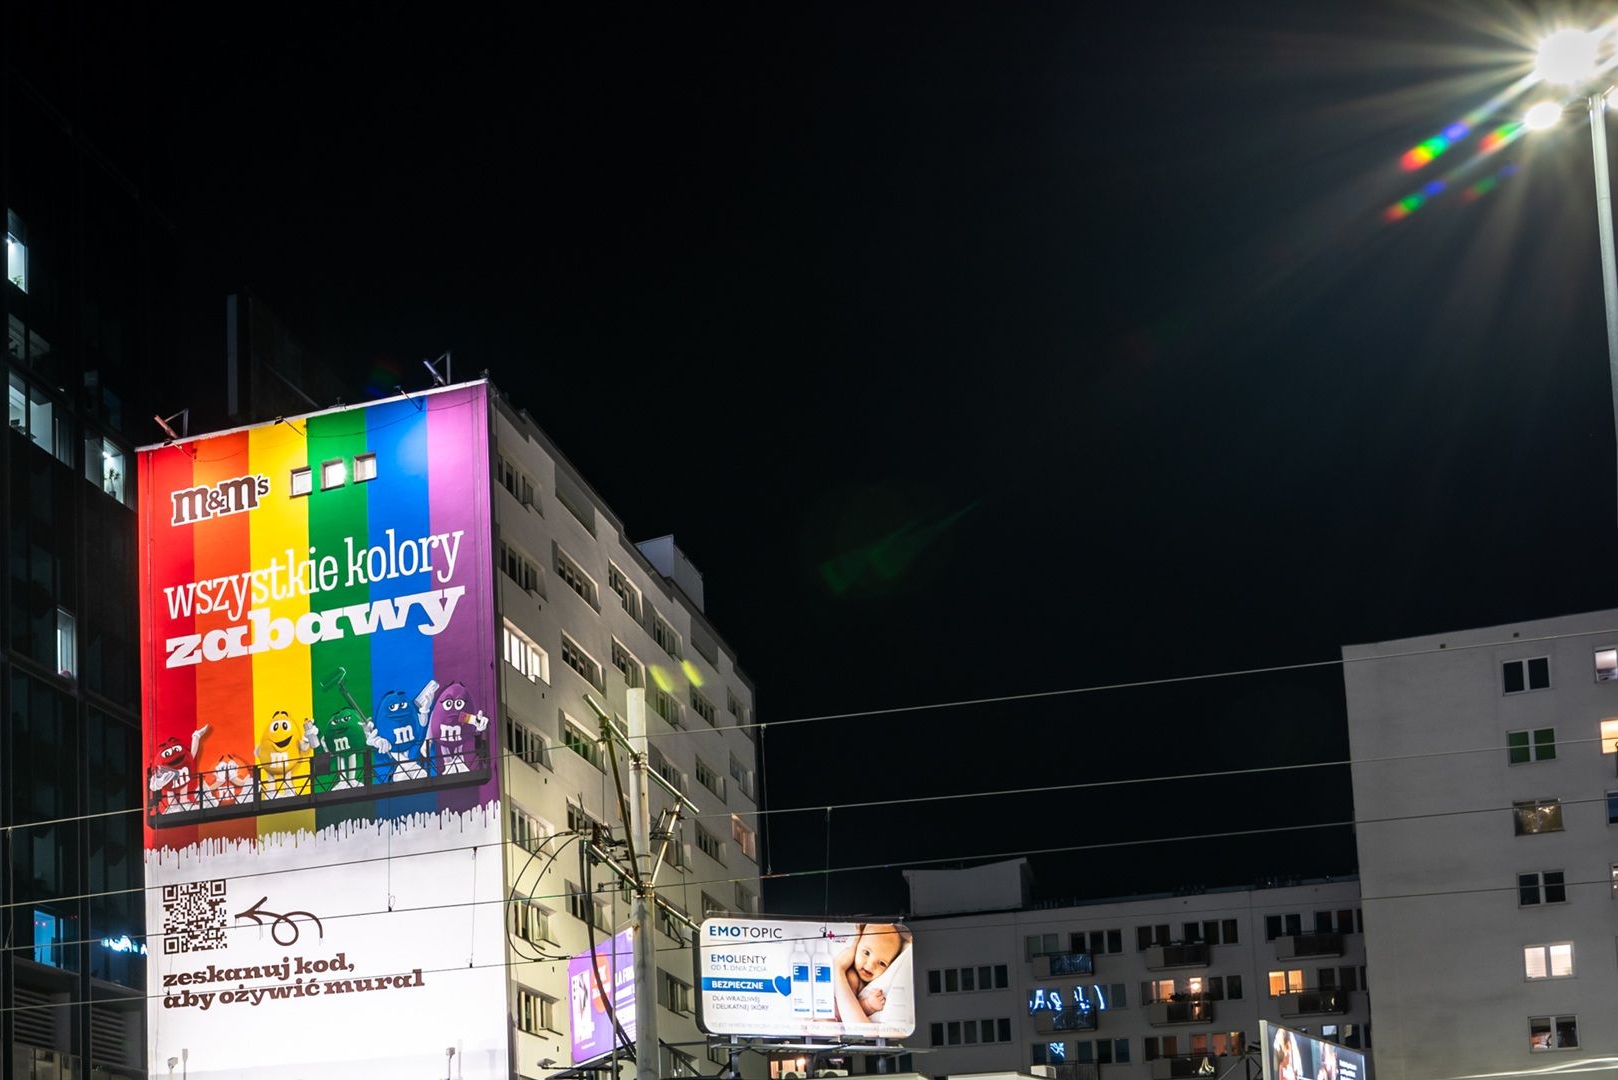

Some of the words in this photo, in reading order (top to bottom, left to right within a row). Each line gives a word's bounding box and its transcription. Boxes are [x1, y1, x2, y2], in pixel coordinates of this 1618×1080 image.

[164, 546, 338, 622] wszystkie
[345, 529, 464, 587] kolory
[165, 585, 465, 669] zabawy
[709, 925, 782, 939] EMOTOPIC
[163, 957, 290, 987] zeskanuj
[294, 953, 355, 976] kod,
[710, 953, 767, 964] EMOLIENTY
[163, 989, 215, 1011] aby
[219, 978, 320, 1006] ożywić
[324, 969, 425, 995] mural
[711, 980, 764, 990] BEZPIECZNE
